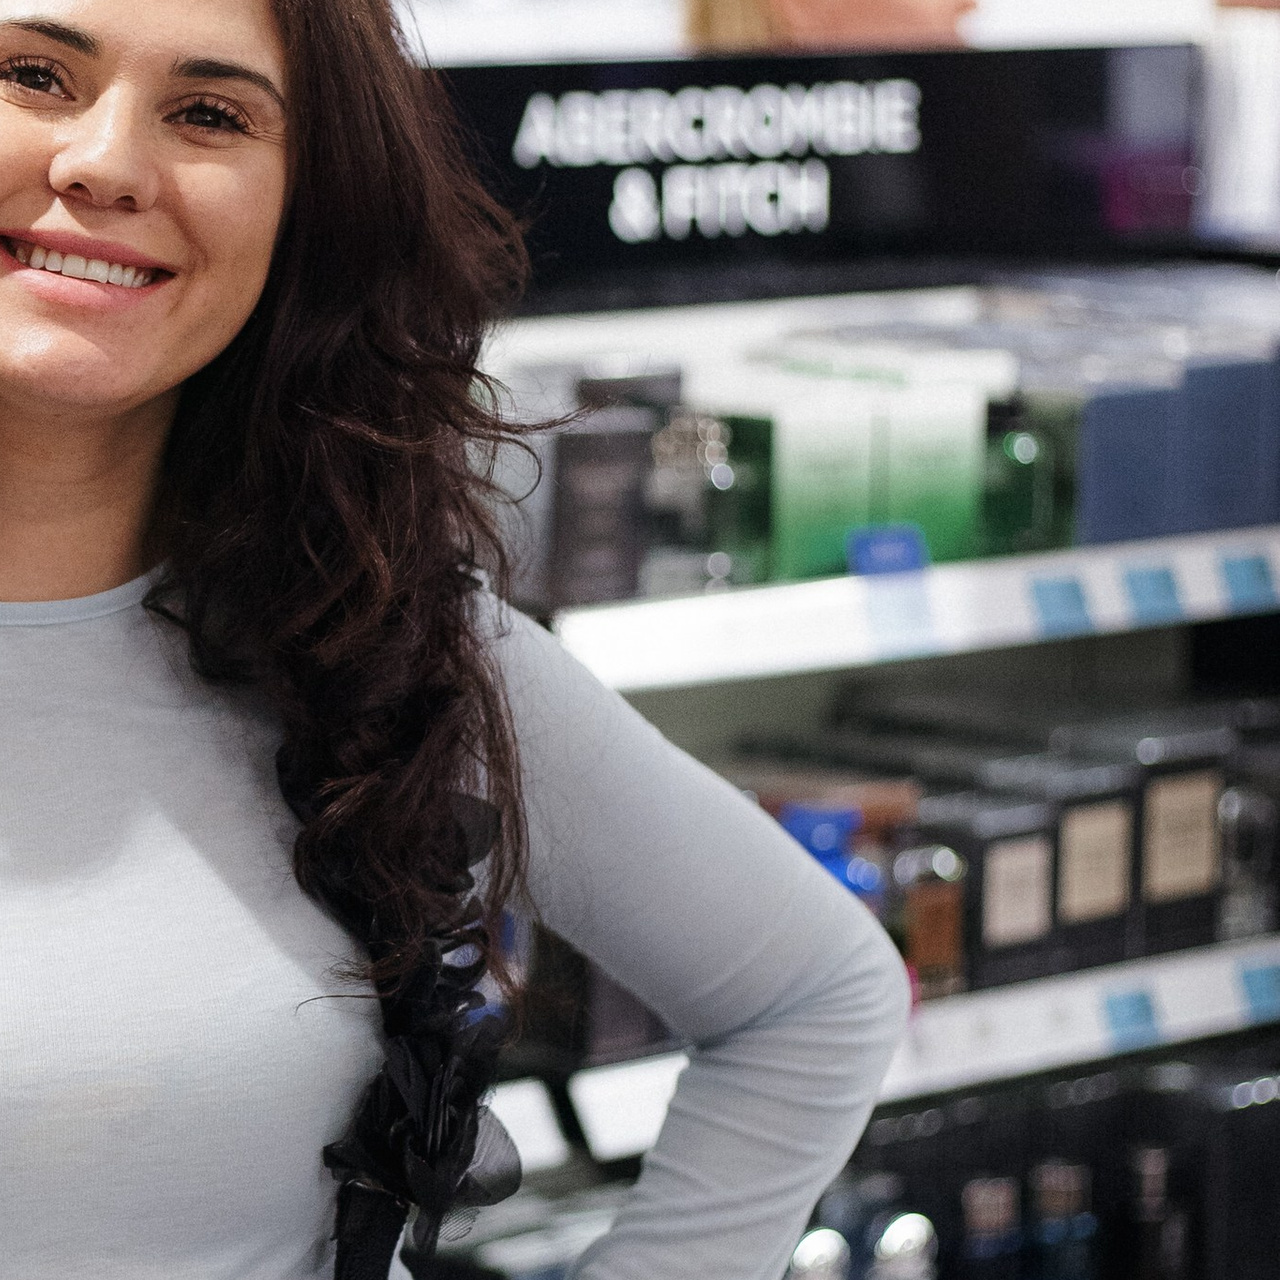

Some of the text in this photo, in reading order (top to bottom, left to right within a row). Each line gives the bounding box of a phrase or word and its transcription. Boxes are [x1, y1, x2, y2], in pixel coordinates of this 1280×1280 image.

[513, 79, 920, 168] ABERCROMBIE
[609, 158, 830, 243] & FITCH
